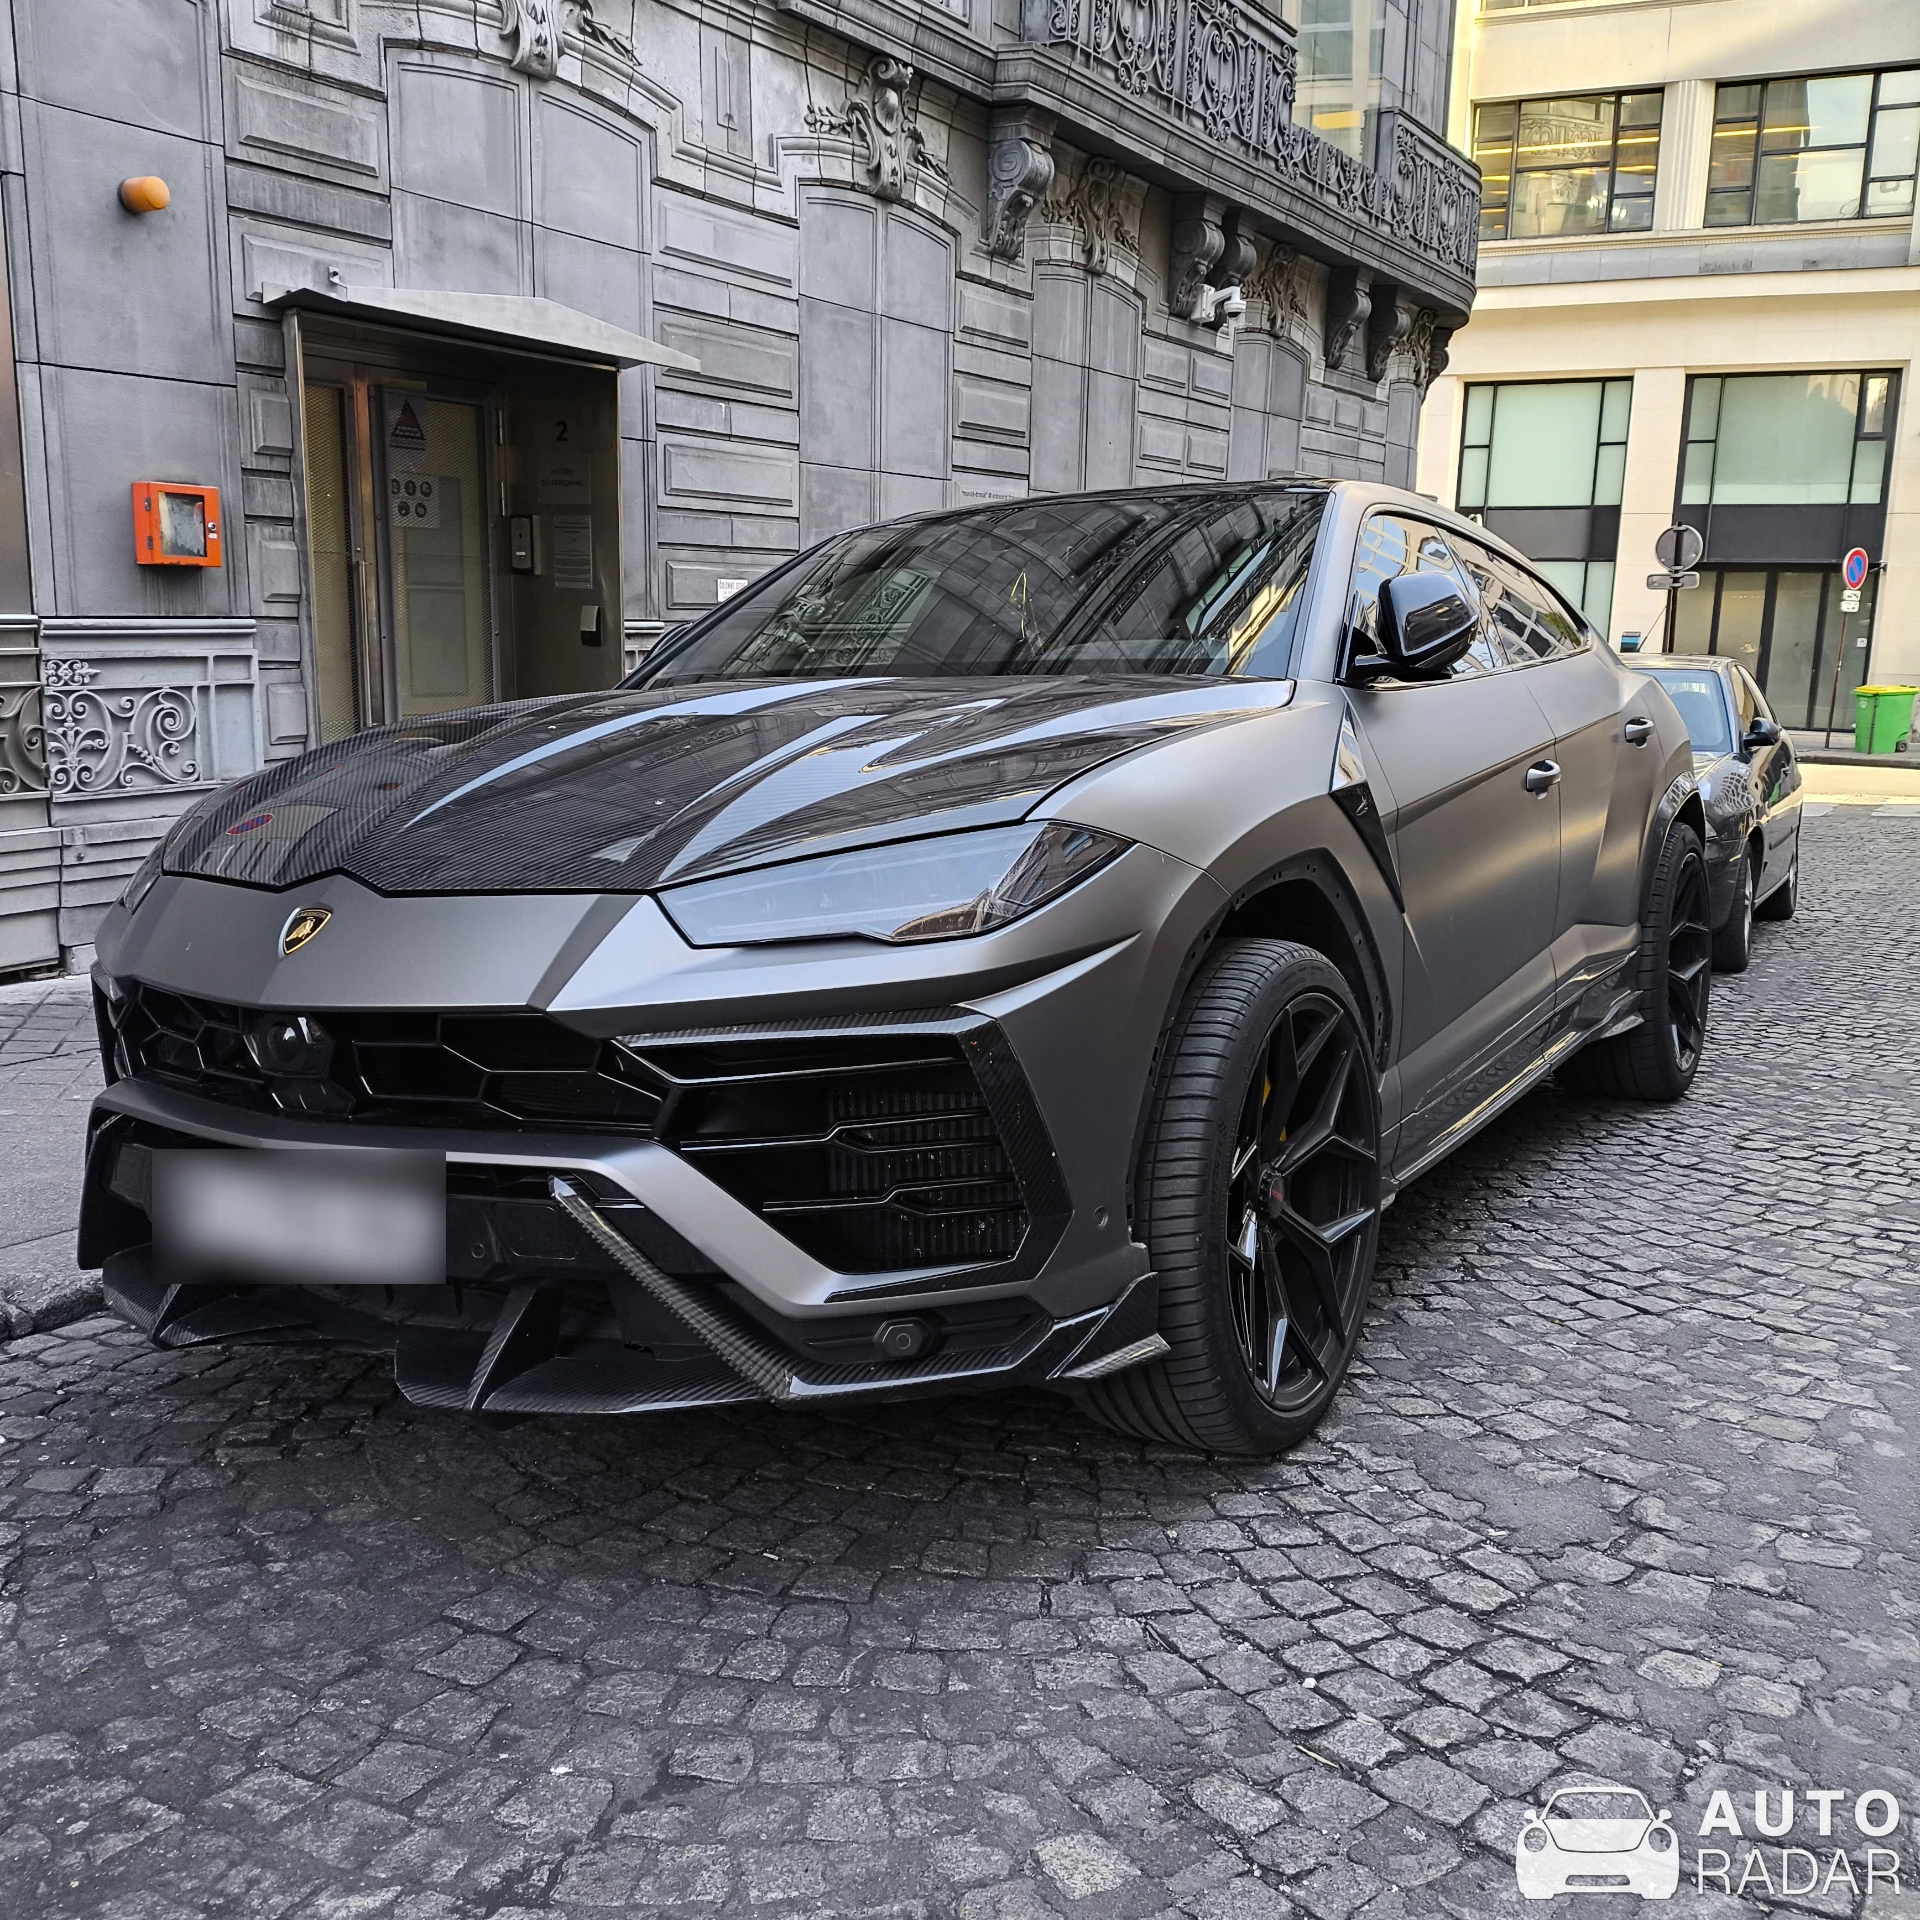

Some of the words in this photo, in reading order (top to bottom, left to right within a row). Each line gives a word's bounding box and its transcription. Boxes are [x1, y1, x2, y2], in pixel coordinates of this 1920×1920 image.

[555, 420, 568, 441] 2
[551, 467, 573, 476] ENTRÉE
[541, 479, 550, 487] DU
